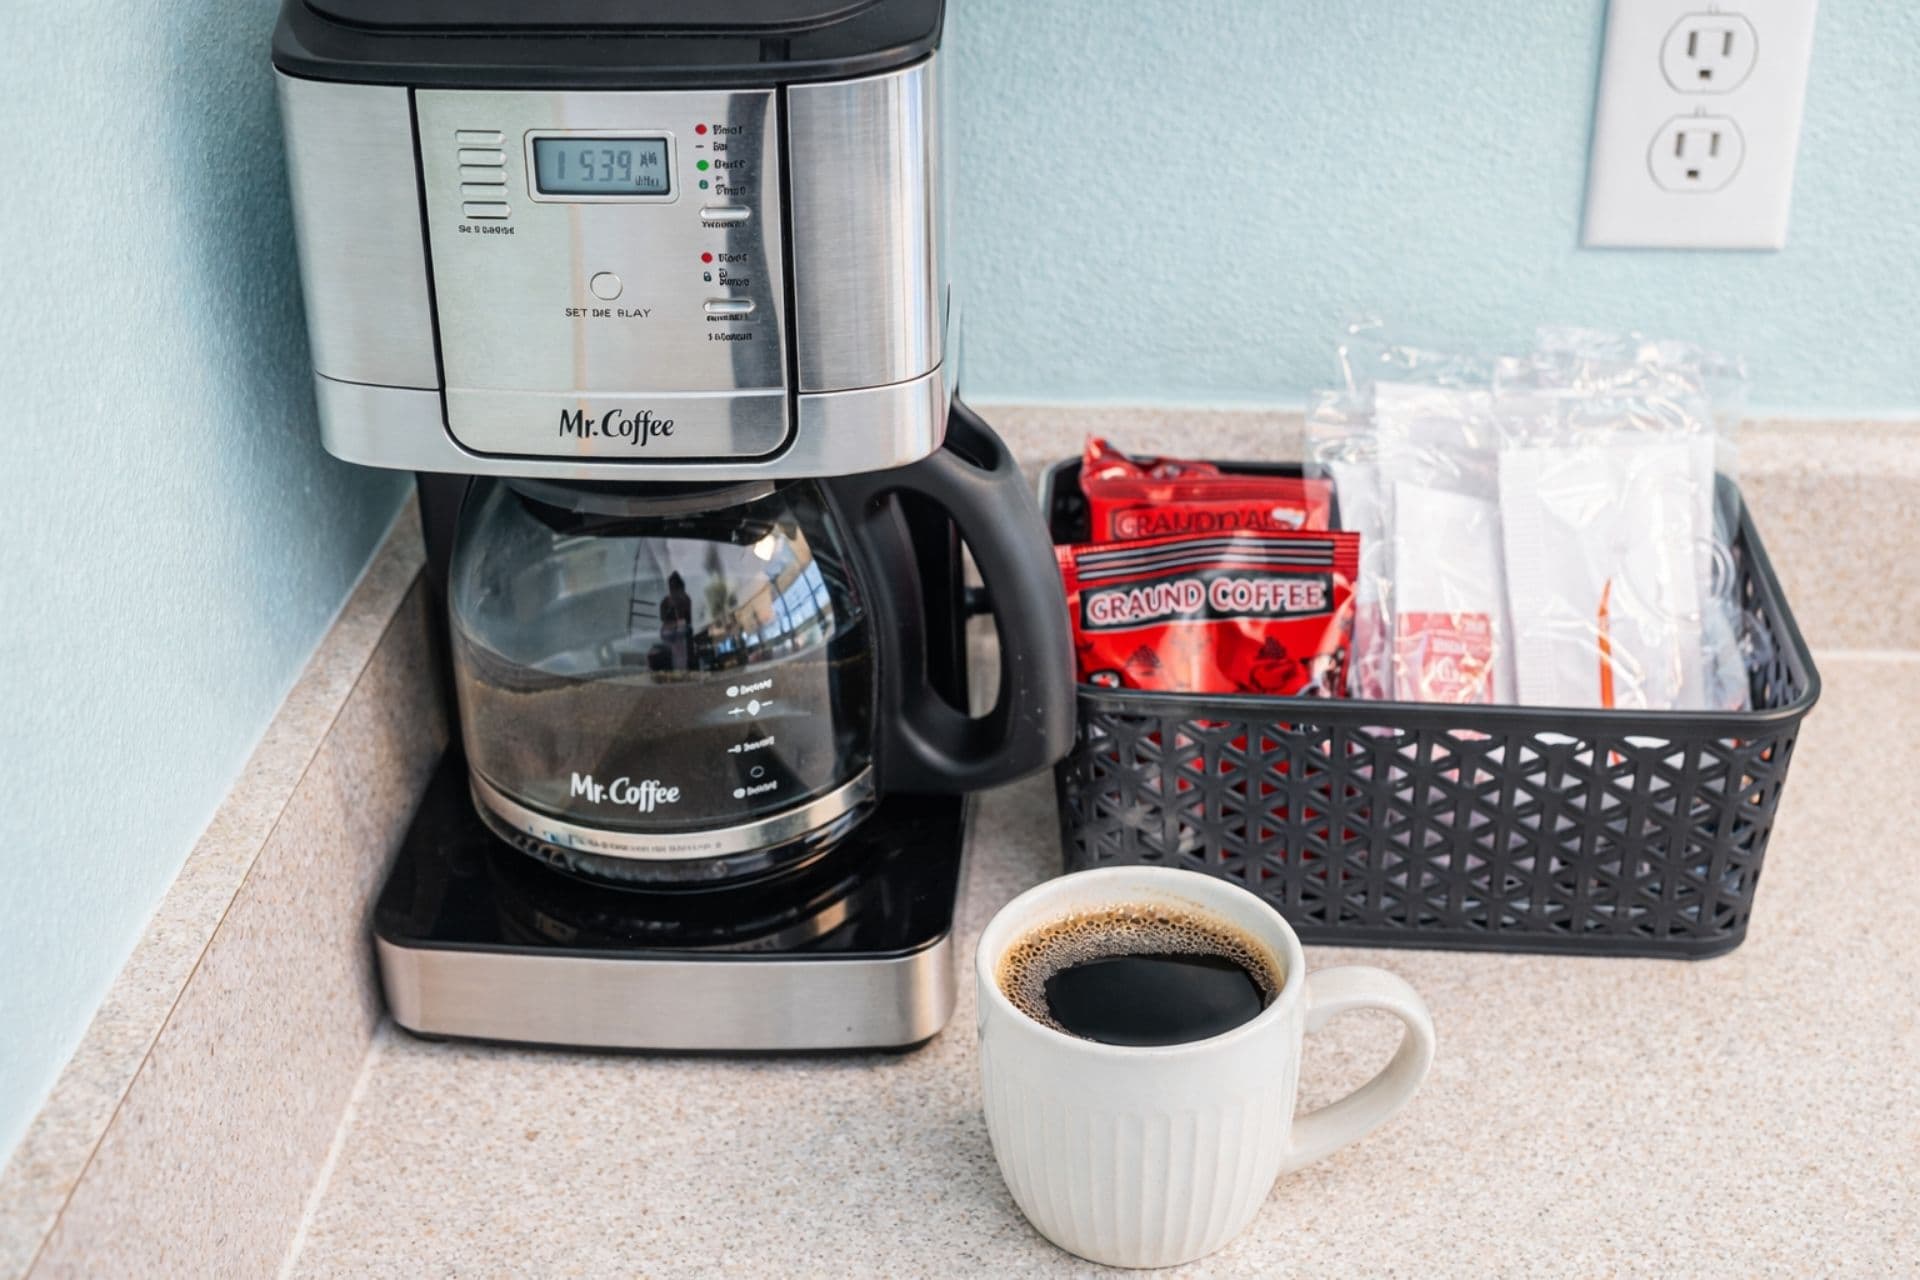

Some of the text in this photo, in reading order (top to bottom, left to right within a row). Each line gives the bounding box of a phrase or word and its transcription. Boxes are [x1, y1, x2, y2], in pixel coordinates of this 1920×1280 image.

[565, 308, 588, 318] SET
[1087, 576, 1326, 625] GRAUND COFFEE
